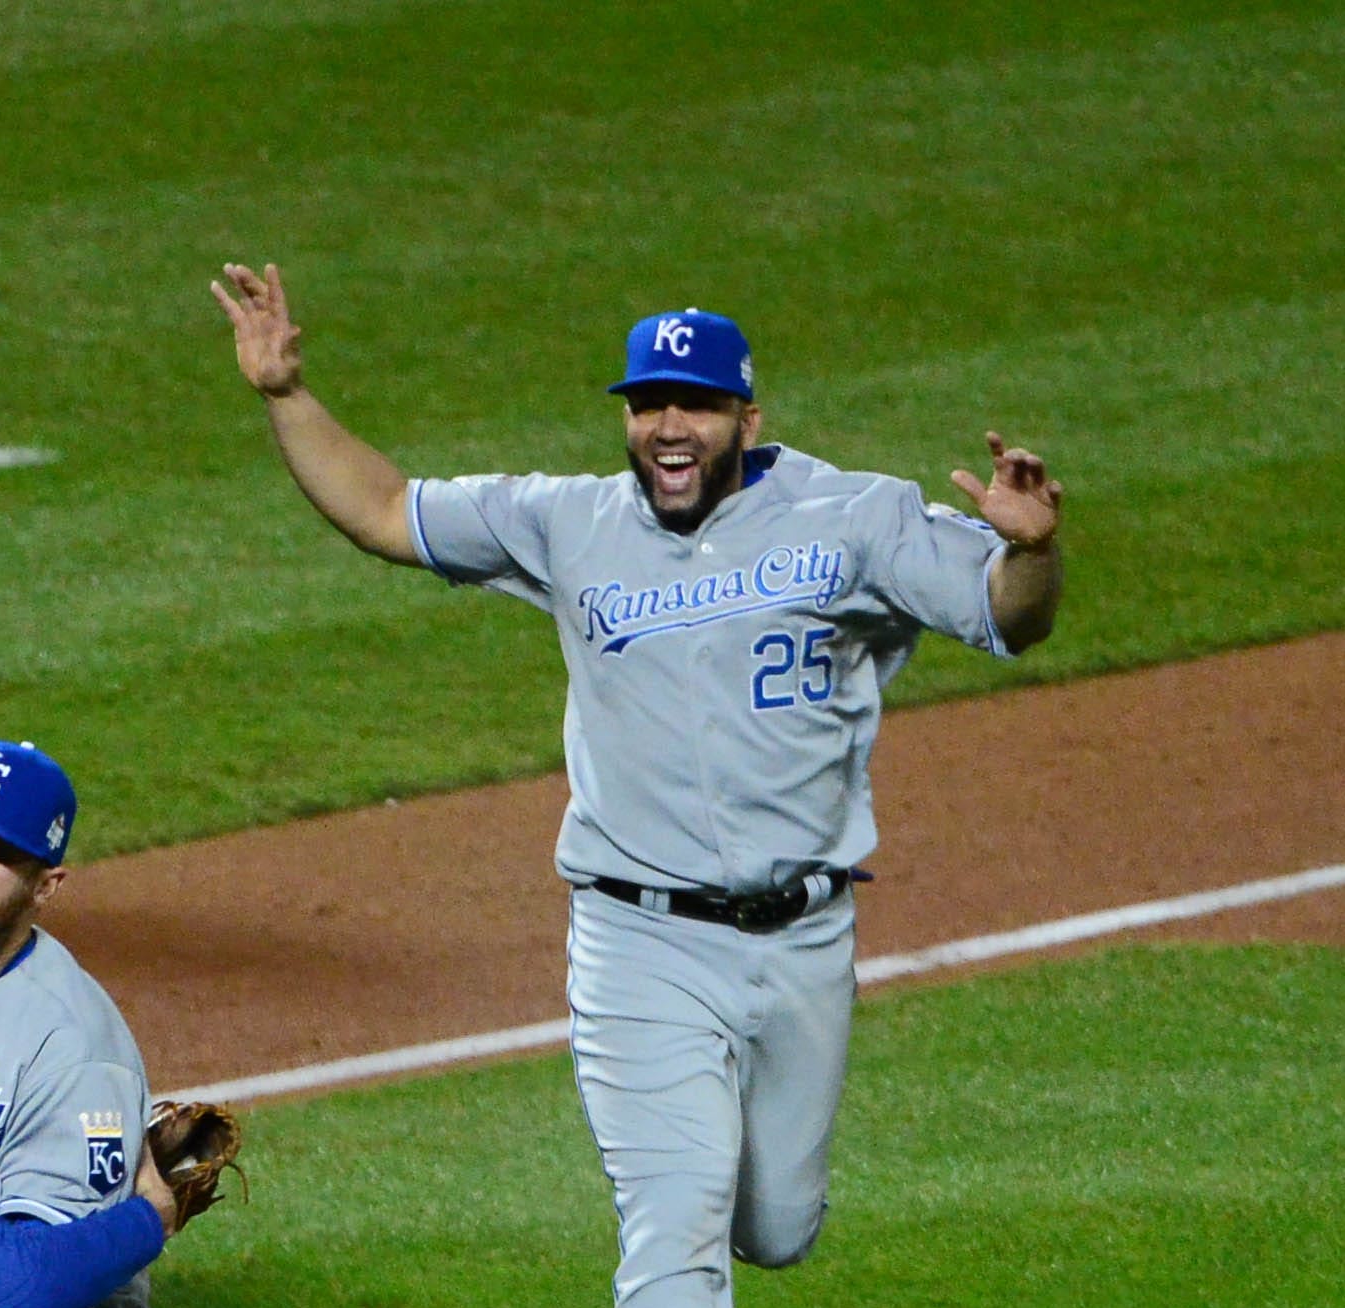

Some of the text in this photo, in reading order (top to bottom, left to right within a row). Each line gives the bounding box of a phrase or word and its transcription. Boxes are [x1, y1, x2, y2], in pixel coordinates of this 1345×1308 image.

[653, 318, 694, 357] KC
[578, 541, 845, 641] Kansas City
[750, 625, 836, 712] 25
[89, 1141, 124, 1185] KC
